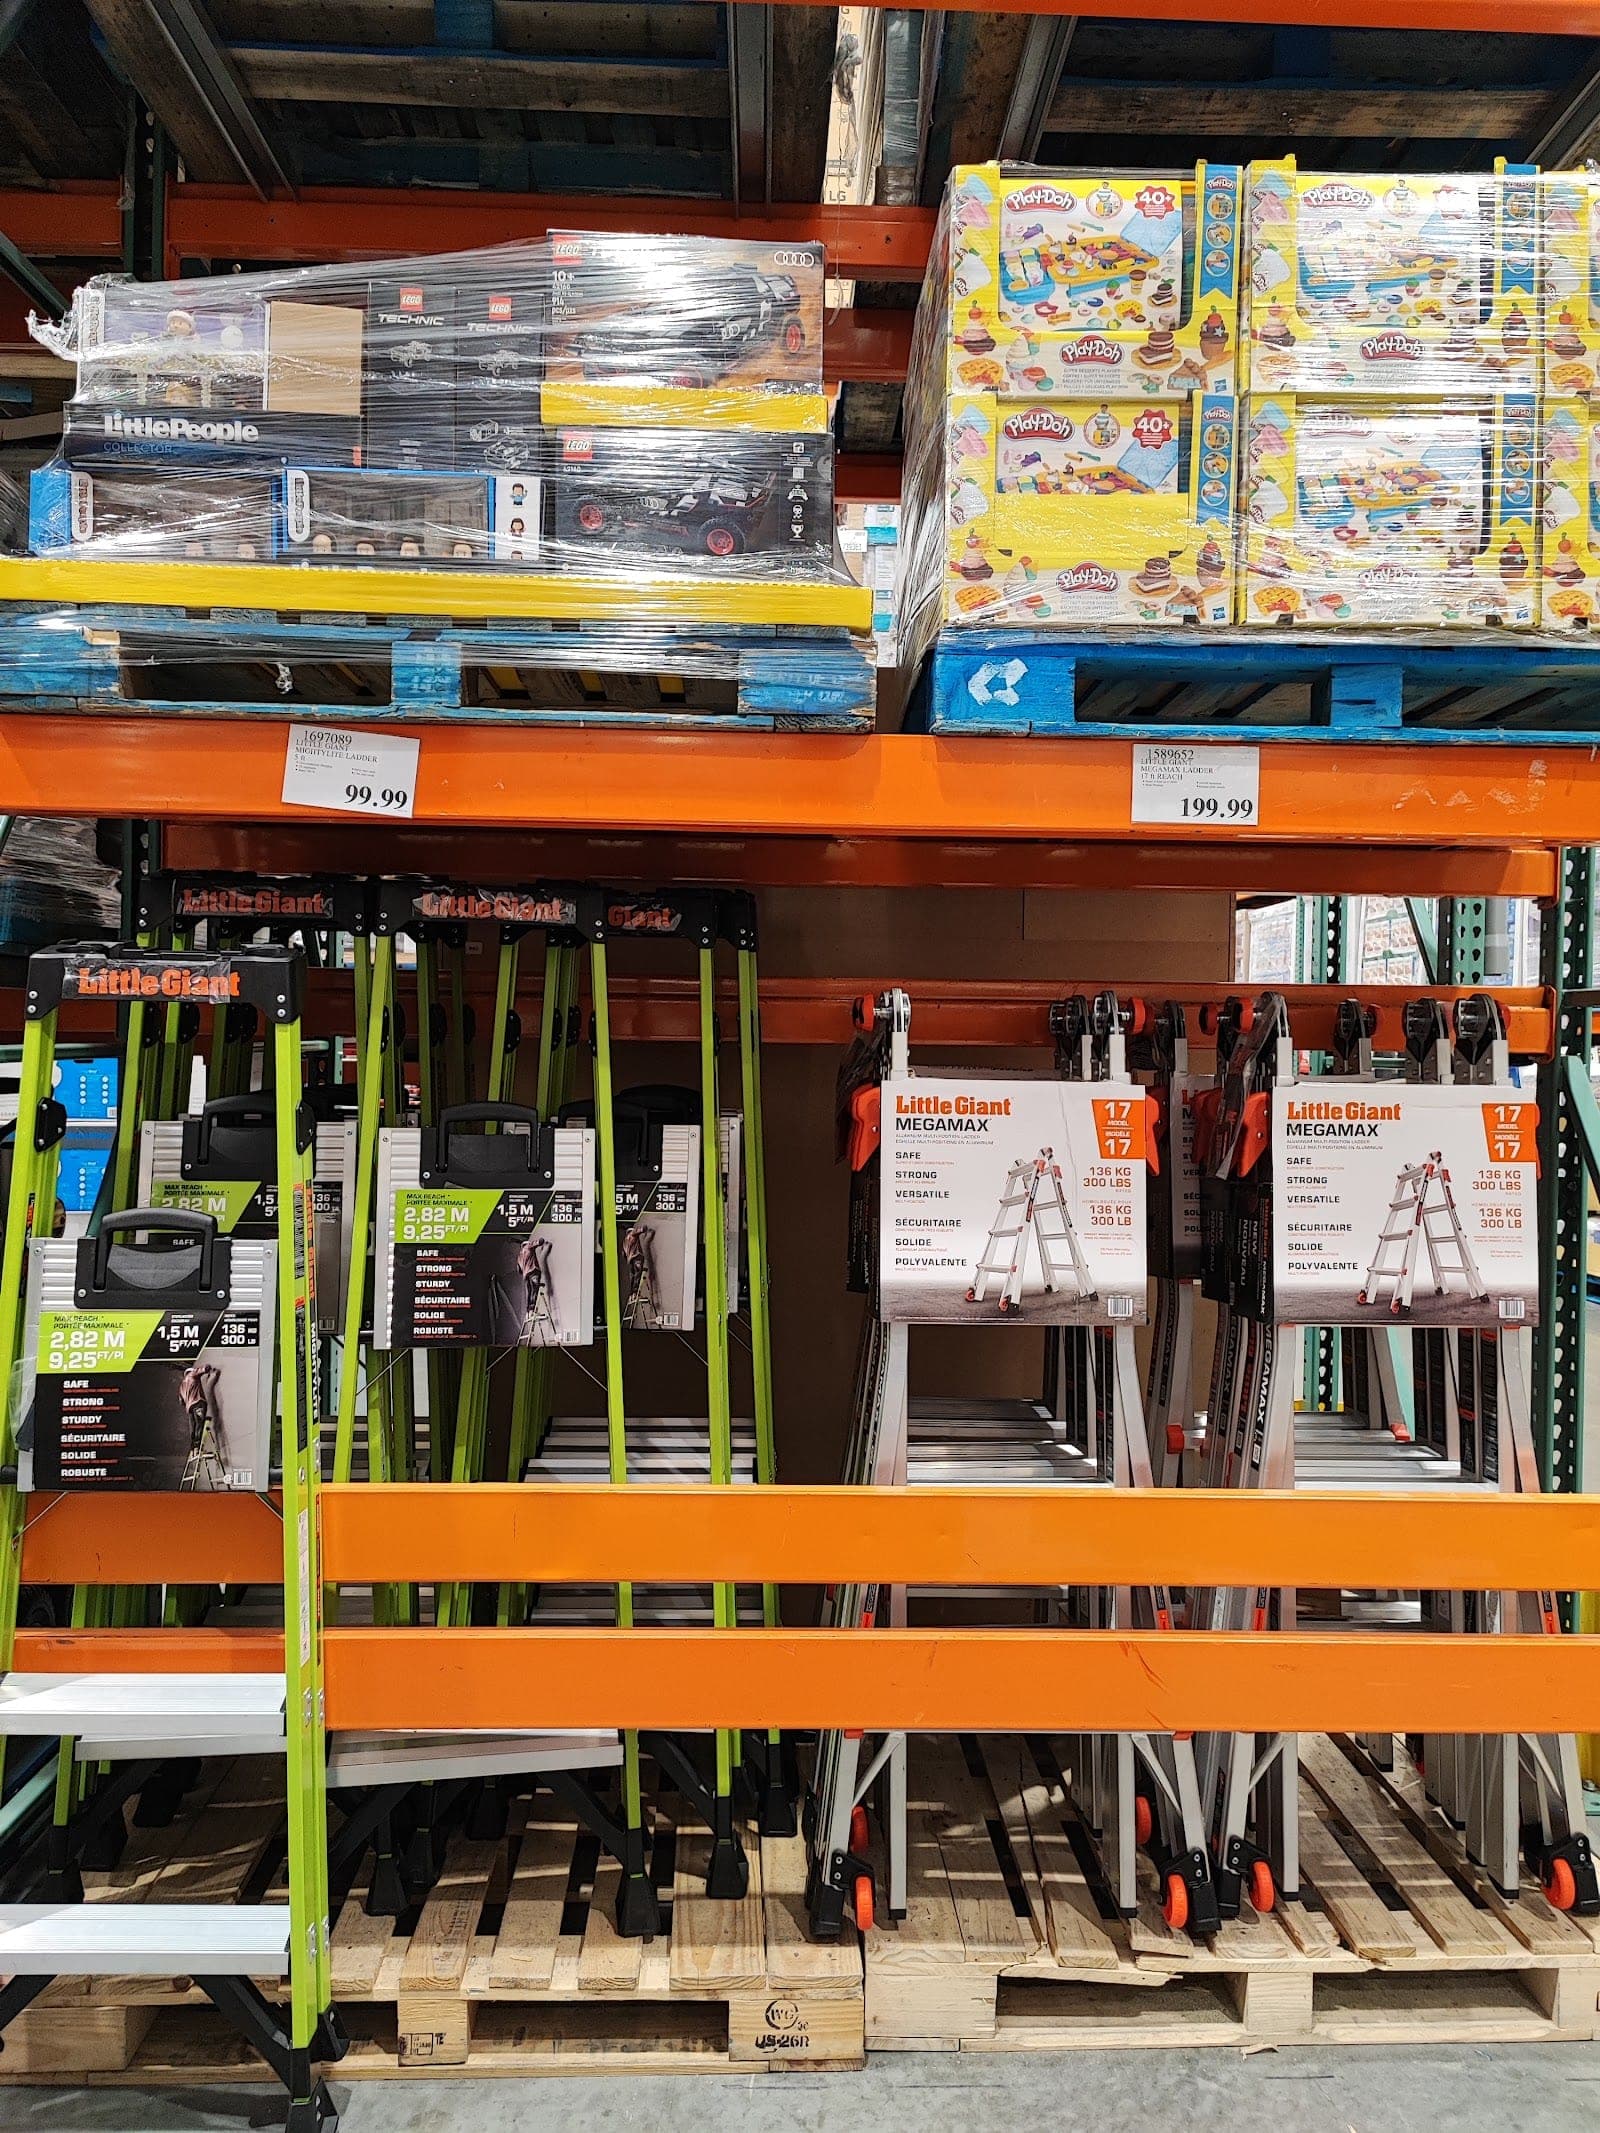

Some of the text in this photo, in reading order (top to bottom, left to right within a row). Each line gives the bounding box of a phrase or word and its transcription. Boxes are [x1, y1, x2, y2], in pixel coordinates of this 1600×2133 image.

[829, 190, 846, 202] LG
[1004, 187, 1075, 211] Play-Doh
[555, 244, 581, 255] LEGO
[401, 294, 421, 304] LEGO
[490, 304, 510, 313] LEGO
[378, 314, 445, 325] TECHNIC
[467, 323, 532, 334] TECHNIC
[1062, 339, 1123, 362] Play-Doh
[1361, 336, 1424, 358] Play-Doh
[1004, 411, 1072, 437] Play-Doh
[1137, 418, 1170, 433] 40+
[103, 442, 172, 454] COLLECTOR
[566, 440, 591, 451] LEGO
[1060, 568, 1117, 589] Play-Doh
[303, 730, 352, 745] 1697089
[296, 739, 350, 752] LITTLE GIANT
[345, 752, 378, 763] LADDER
[1147, 749, 1194, 760] 1589652
[1169, 758, 1192, 766] GIANT
[344, 784, 408, 810] 99.99
[1180, 798, 1253, 819] 199.99
[184, 889, 323, 914] Little Giant
[421, 892, 562, 922] Little Giant
[608, 904, 672, 927] Giant
[77, 967, 241, 997] Little Giant
[896, 1095, 1011, 1116] Little Giant
[1104, 1102, 1131, 1119] 17
[1287, 1101, 1401, 1120] Little Giant
[1494, 1105, 1522, 1122] 17
[895, 1118, 989, 1132] MEGAMAX
[1286, 1123, 1379, 1137] MEGAMAX
[1104, 1138, 1132, 1155] 17
[1494, 1141, 1521, 1159] 17
[1286, 1157, 1312, 1165] SAFE
[895, 1171, 937, 1179] STRONG
[1090, 1167, 1132, 1177] 136 KG
[1479, 1170, 1521, 1179] 136 KG
[1083, 1178, 1132, 1188] 300 LBS
[1287, 1176, 1328, 1184] STRONG
[1472, 1181, 1521, 1191] 300 LBS
[626, 1194, 638, 1204] M
[656, 1194, 676, 1202] 136
[895, 1190, 950, 1198] VERSATILE
[1287, 1195, 1340, 1203] VERSATILE
[208, 1199, 226, 1211] M
[552, 1204, 573, 1213] 136
[655, 1202, 676, 1210] 300
[1090, 1205, 1132, 1215] 136 KG
[404, 1207, 469, 1224] 2,82 M
[497, 1204, 533, 1217] 1,5 M
[1479, 1208, 1522, 1217] 136 KG
[551, 1213, 573, 1222] 300
[895, 1217, 962, 1227] SÉCURITAIRE
[1091, 1216, 1132, 1226] 300 LB
[1287, 1222, 1353, 1232] SÉCURITAIRE
[1480, 1219, 1522, 1229] 300 LB
[895, 1238, 932, 1246] SOLIDE
[1288, 1243, 1323, 1251] SOLIDE
[416, 1249, 439, 1257] SAFE
[1240, 1219, 1249, 1286] NOUVEAU
[895, 1257, 968, 1267] POLYVALENTE
[1288, 1262, 1359, 1270] POLYVALENTE
[415, 1280, 450, 1288] STURDY
[414, 1295, 471, 1304] SÉCURITAIRE
[414, 1311, 445, 1319] SOLIDE
[157, 1326, 199, 1341] 1,5 M
[221, 1325, 244, 1334] 136
[413, 1327, 454, 1335] ROBUSTE
[50, 1331, 125, 1351] 2,82 M
[220, 1335, 244, 1345] 300
[1223, 1316, 1238, 1392] EGAMAX
[63, 1380, 89, 1388] SAFE
[62, 1398, 104, 1406] STRONG
[61, 1415, 102, 1424] STURDY
[60, 1432, 126, 1442] SÉCURITAIRE
[60, 1451, 97, 1459] SOLIDE
[60, 1468, 107, 1477] ROBUSTE
